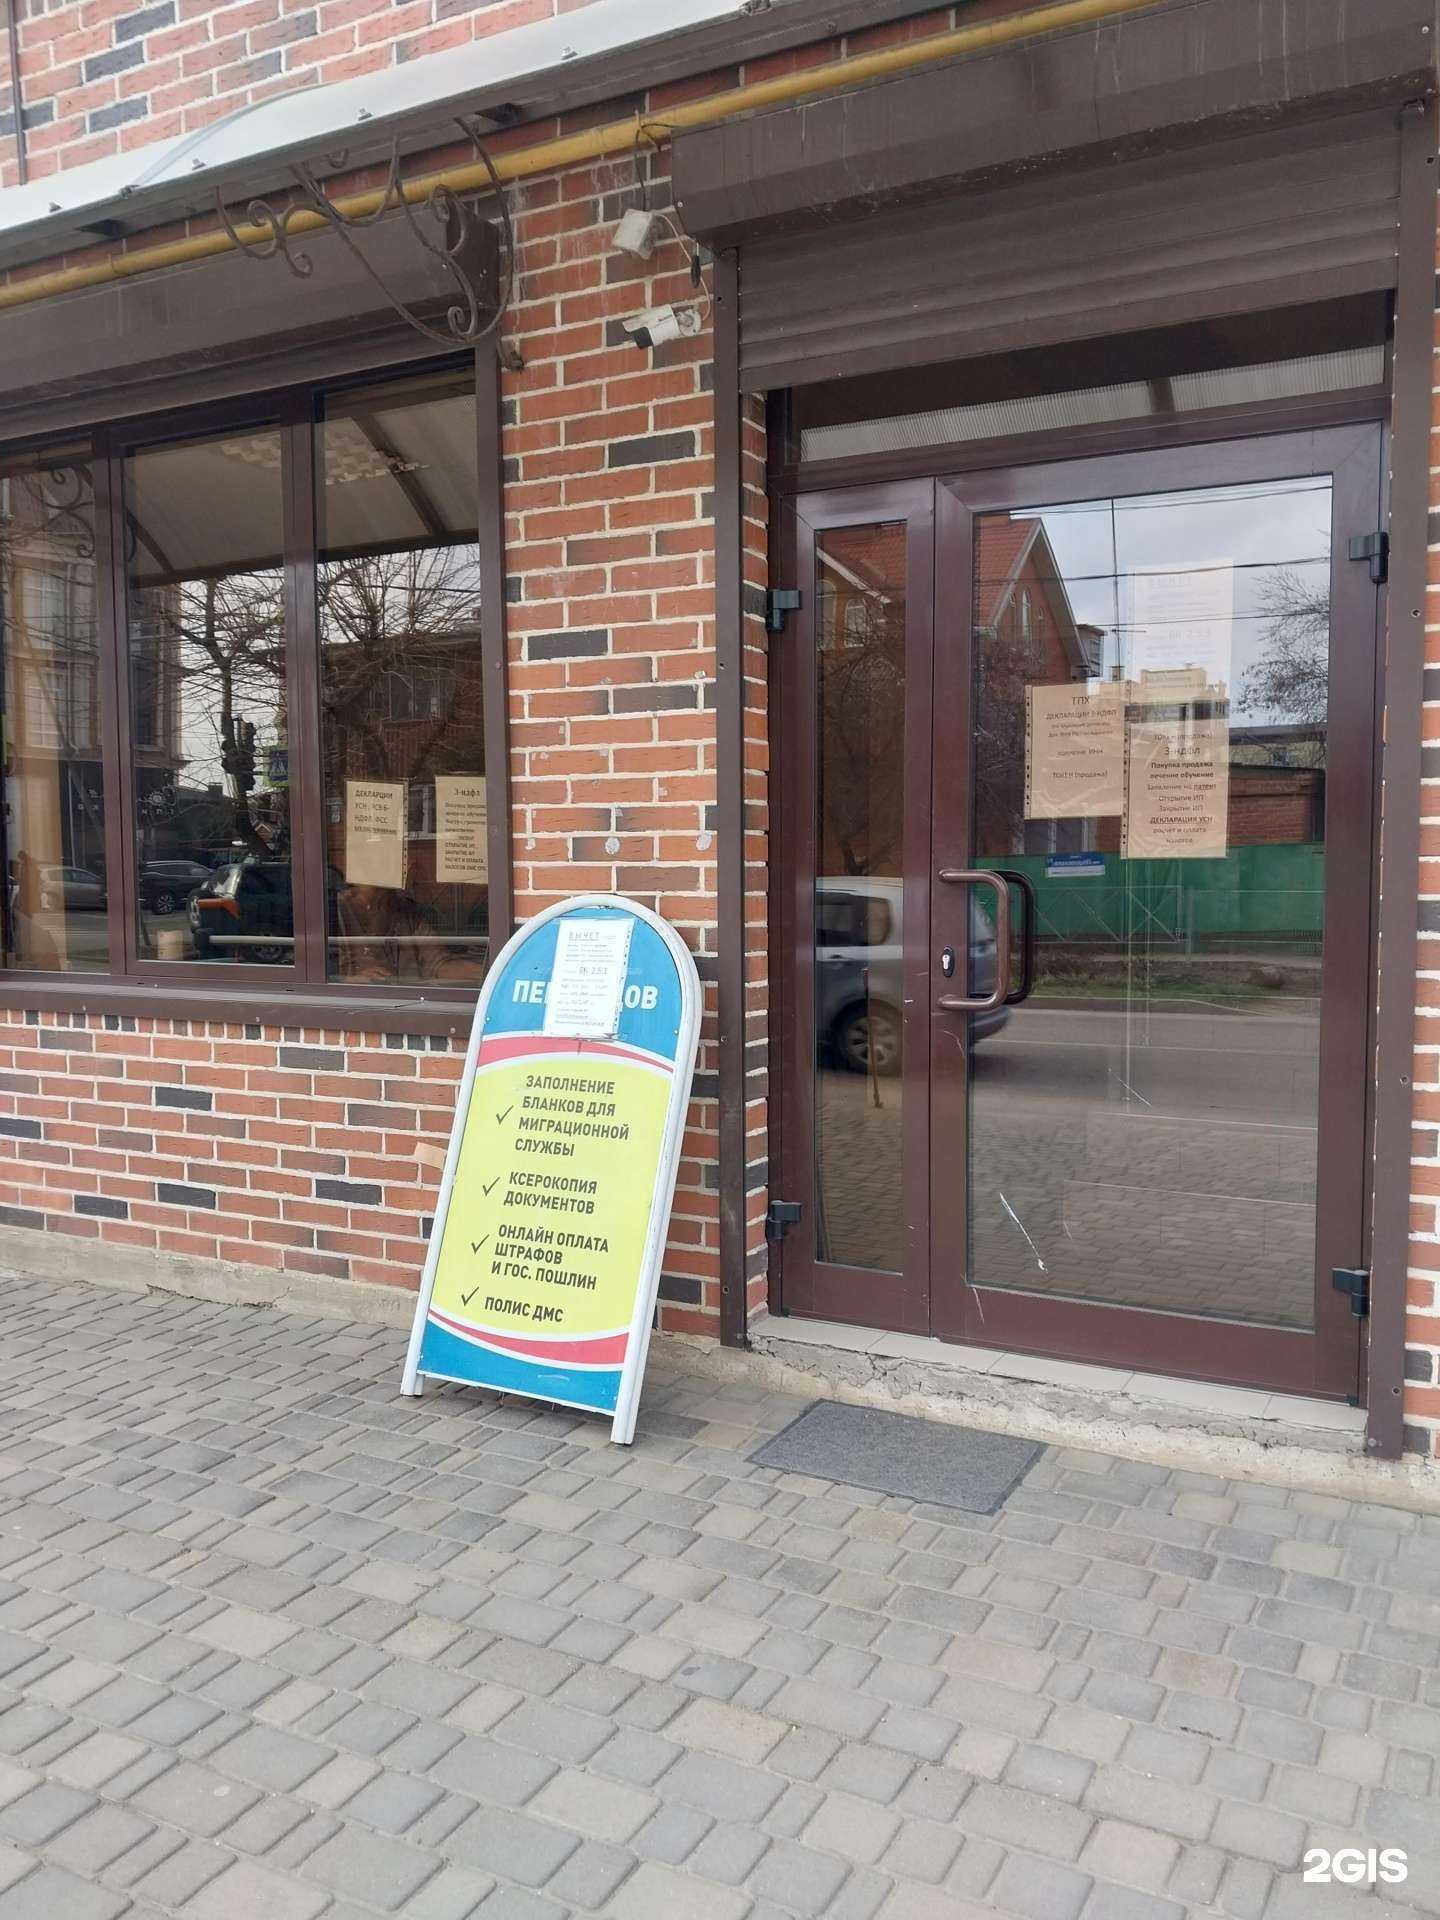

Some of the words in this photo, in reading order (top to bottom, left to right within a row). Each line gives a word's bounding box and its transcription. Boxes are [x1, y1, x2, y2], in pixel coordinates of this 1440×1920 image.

[526, 1075, 615, 1095] ЗАПОЛНЕНИЕ
[522, 1096, 584, 1114] БЛАНКОВ
[586, 1101, 616, 1118] ДЛЯ
[518, 1117, 630, 1140] МИГРАЦИОННОЙ
[515, 1138, 575, 1157] СЛУЖБЫ
[509, 1171, 597, 1195] КСЕРОКОПИЯ
[504, 1191, 595, 1215] ДОКУМЕНТОВ
[498, 1224, 554, 1245] ОНЛАЙН
[556, 1232, 609, 1253] ОПЛАТА
[494, 1243, 563, 1265] ШТРАФОВ
[491, 1261, 501, 1275] И
[504, 1263, 532, 1280] ГОС.
[535, 1267, 597, 1290] ПОШЛИН
[484, 1296, 530, 1317] ПОЛИС
[532, 1305, 564, 1322] ДМС
